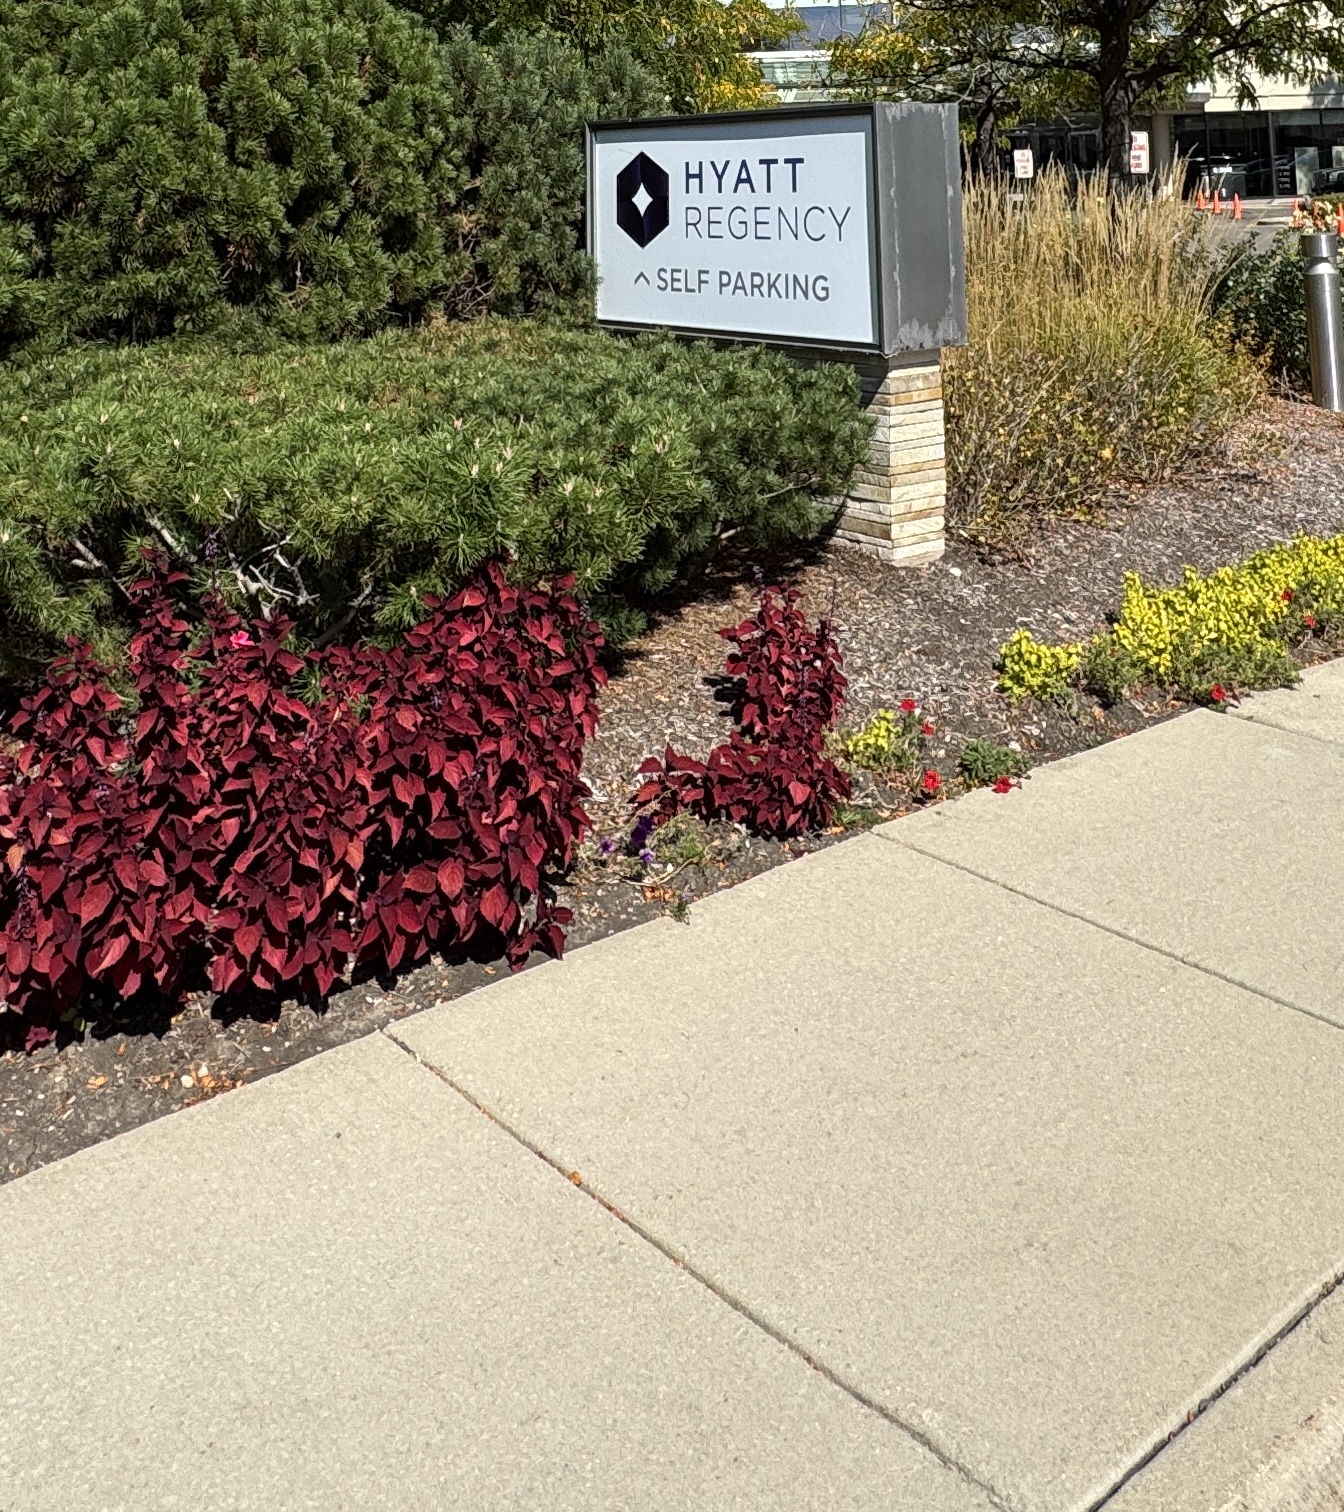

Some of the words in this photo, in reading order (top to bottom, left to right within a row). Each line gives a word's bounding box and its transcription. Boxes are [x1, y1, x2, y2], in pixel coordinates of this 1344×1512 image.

[684, 157, 805, 194] HYATT
[684, 206, 851, 242] REGENCY
[656, 267, 710, 294] SELF
[718, 270, 830, 302] PARKING
